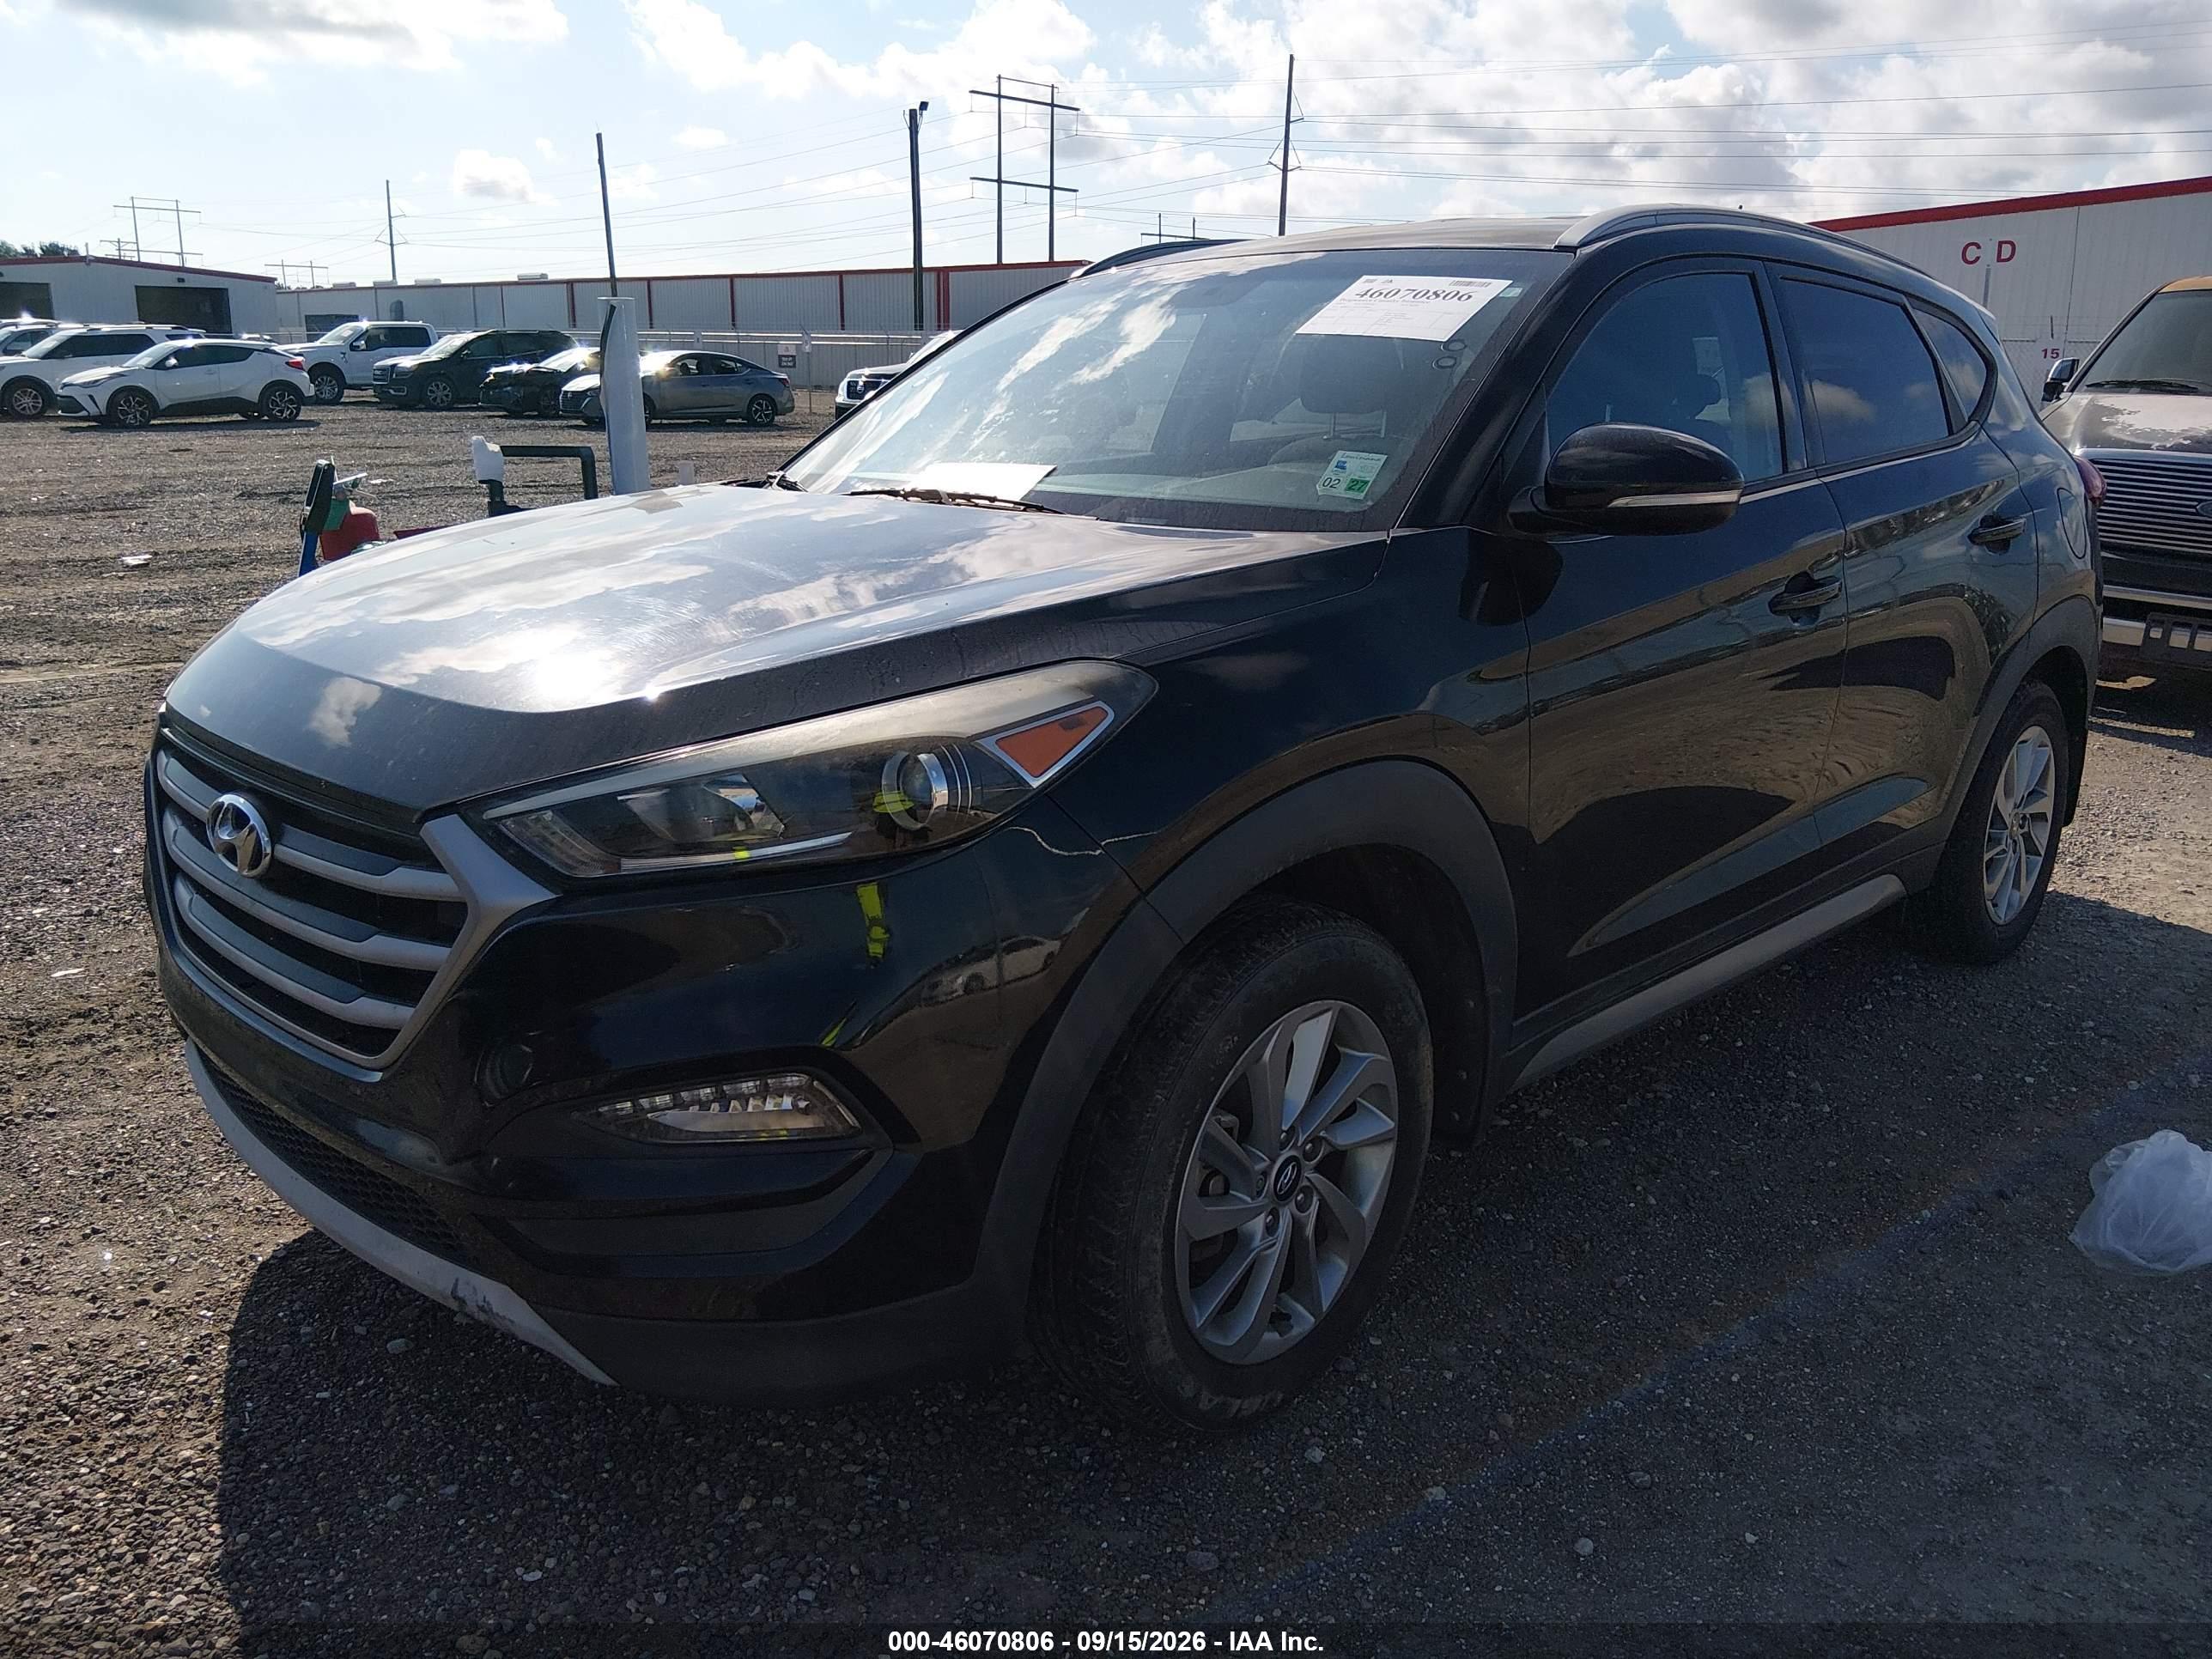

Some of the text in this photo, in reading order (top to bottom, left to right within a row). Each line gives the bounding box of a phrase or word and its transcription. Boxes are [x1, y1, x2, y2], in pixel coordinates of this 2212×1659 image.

[1961, 240, 2017, 265] C D
[1355, 288, 1477, 301] 46070806
[2041, 348, 2061, 360] 15
[1322, 477, 1341, 489] 02
[1347, 479, 1368, 491] 27
